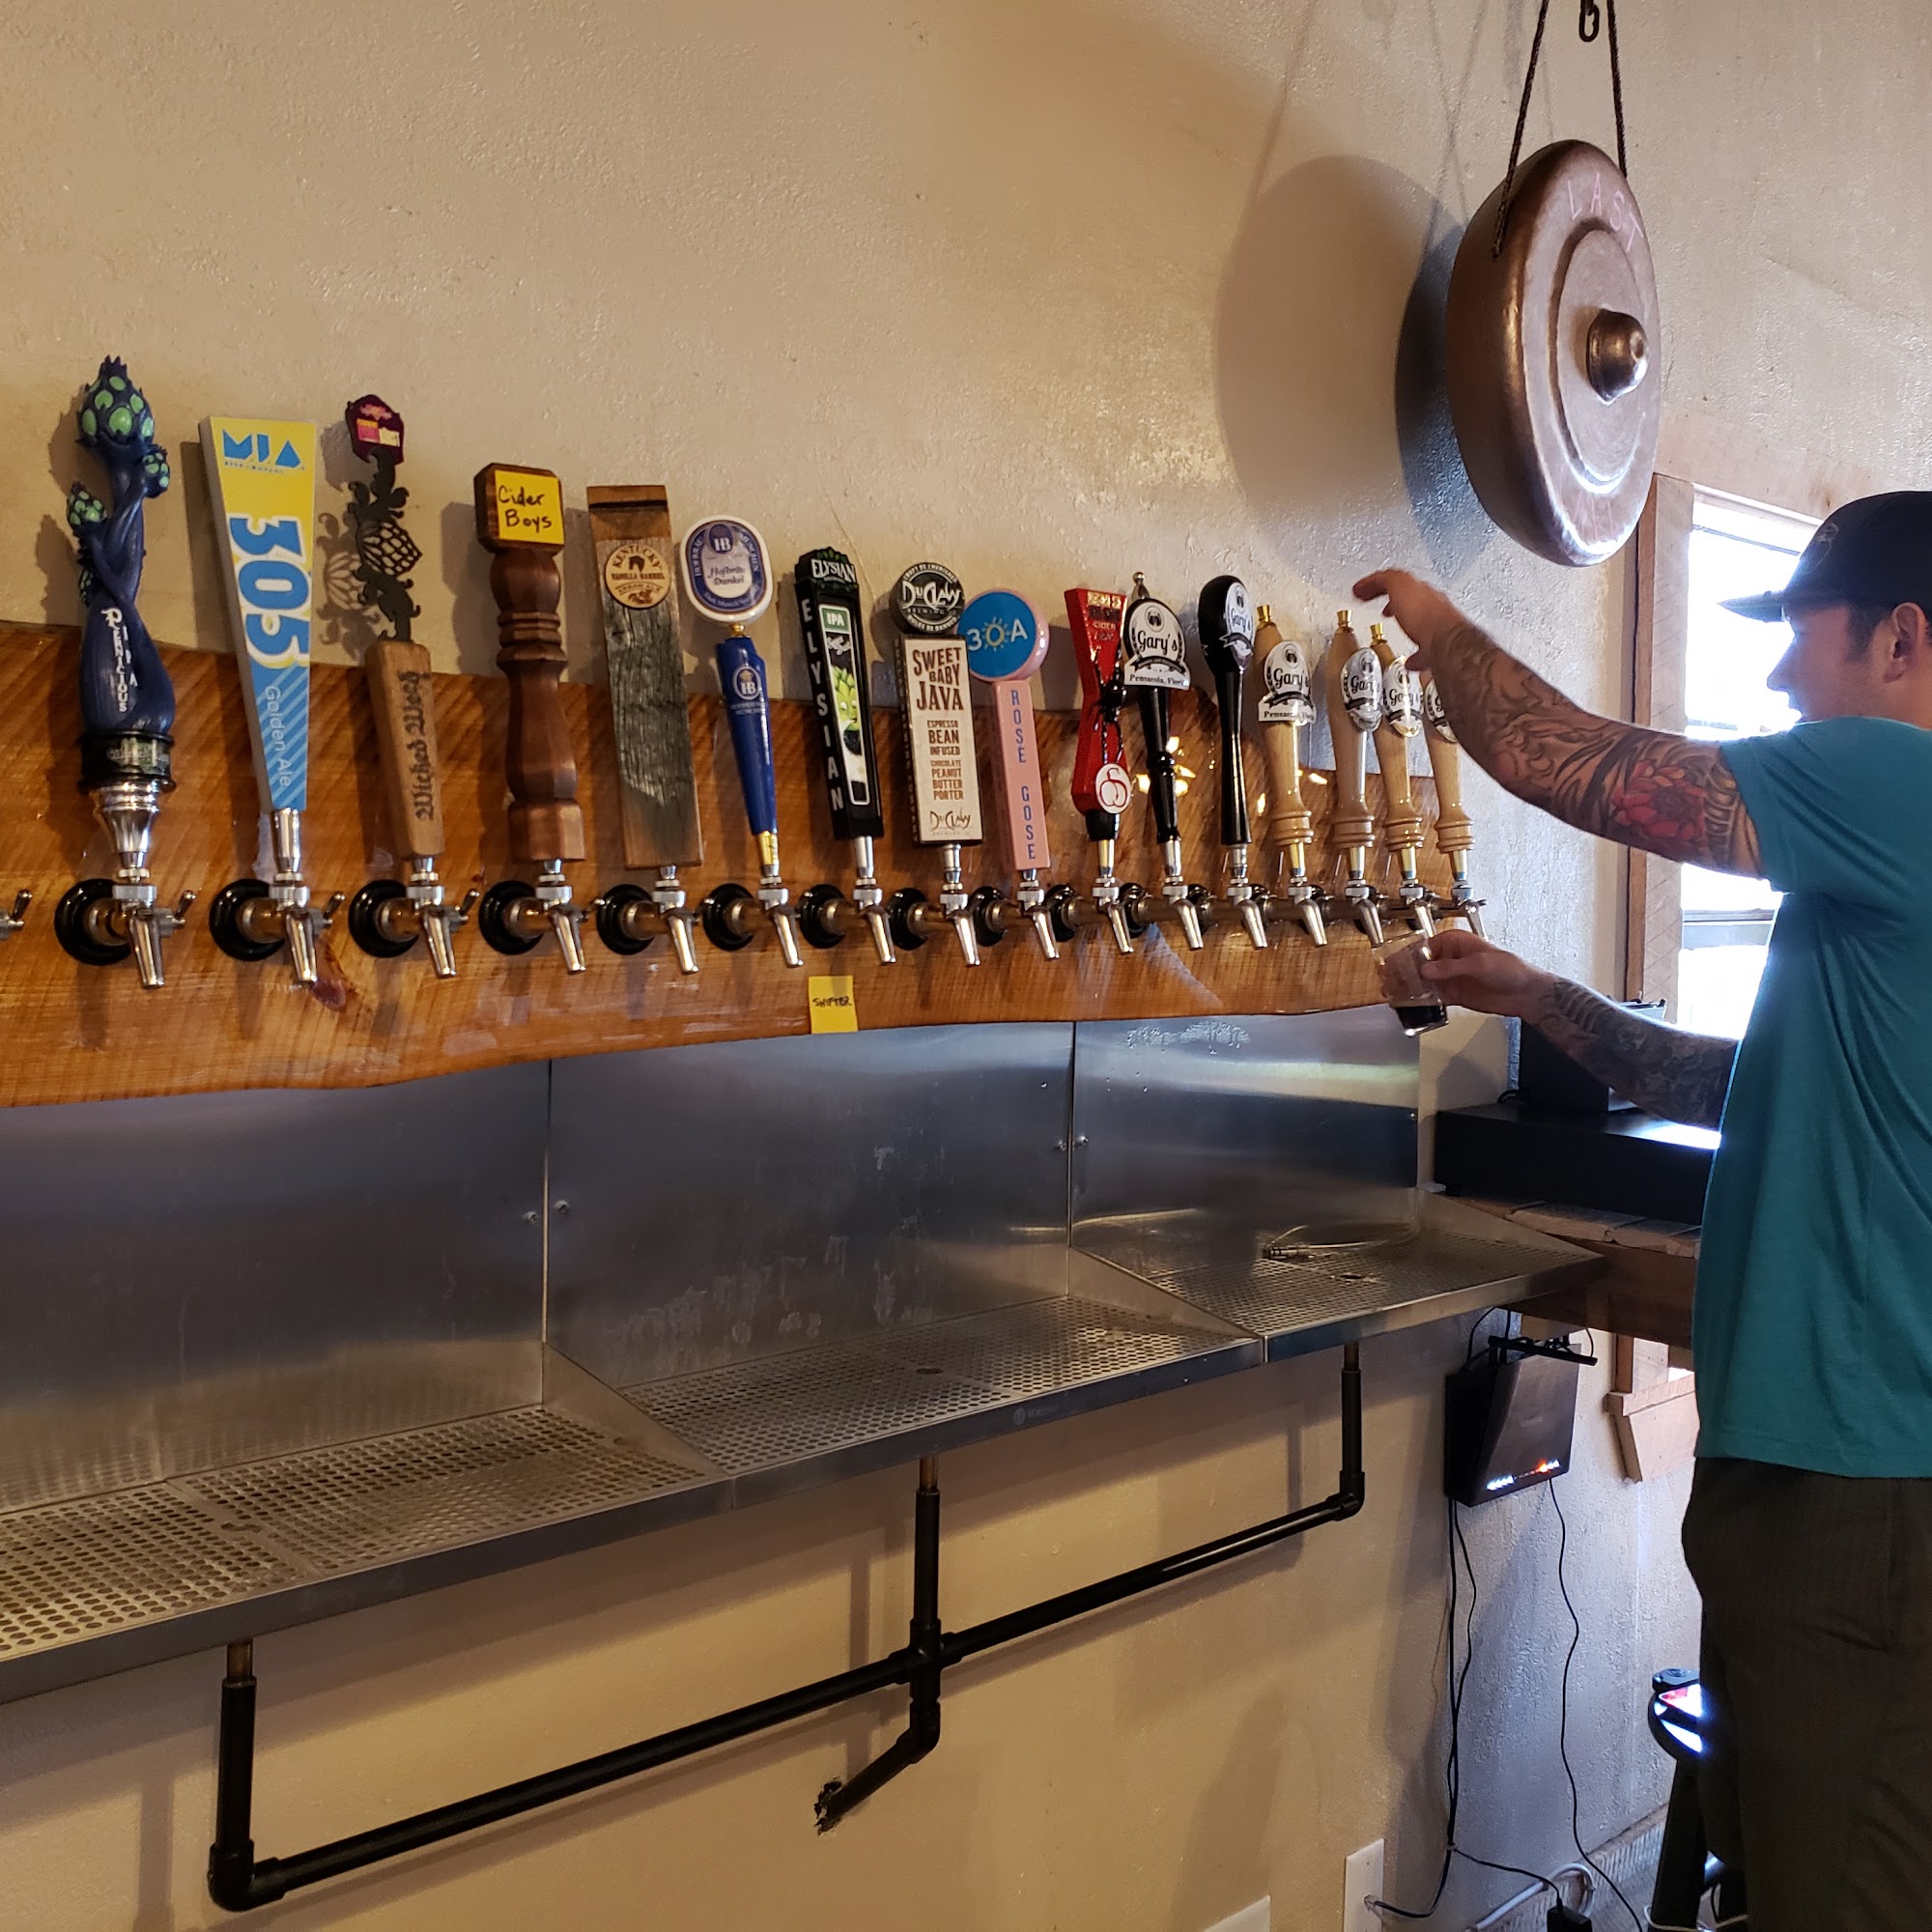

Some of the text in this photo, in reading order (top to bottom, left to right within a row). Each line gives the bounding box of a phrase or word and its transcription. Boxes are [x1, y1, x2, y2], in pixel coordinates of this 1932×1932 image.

[1567, 172, 1645, 252] LAST
[221, 428, 301, 469] MIA
[497, 484, 546, 507] Cider
[505, 508, 553, 533] Boys
[714, 536, 732, 552] HB
[810, 557, 857, 583] ELYSIAN
[227, 515, 311, 659] 305
[826, 611, 845, 627] IPA
[1137, 630, 1178, 656] Gary's
[122, 625, 139, 687] IPA
[912, 647, 959, 676] SWEET
[928, 663, 960, 687] BABY
[740, 681, 756, 695] HB
[916, 681, 965, 711] JAVA
[801, 599, 844, 811] ELYSIAN
[265, 685, 292, 787] Golden Ale
[926, 720, 958, 728] ESPRESSO
[928, 729, 959, 744] BEAN
[929, 746, 961, 755] INFUSED
[406, 738, 435, 821] Wicked
[931, 768, 962, 779] PEANUT
[932, 779, 963, 789] BUTTER
[933, 790, 964, 801] PORTER
[1021, 785, 1037, 860] GOSE
